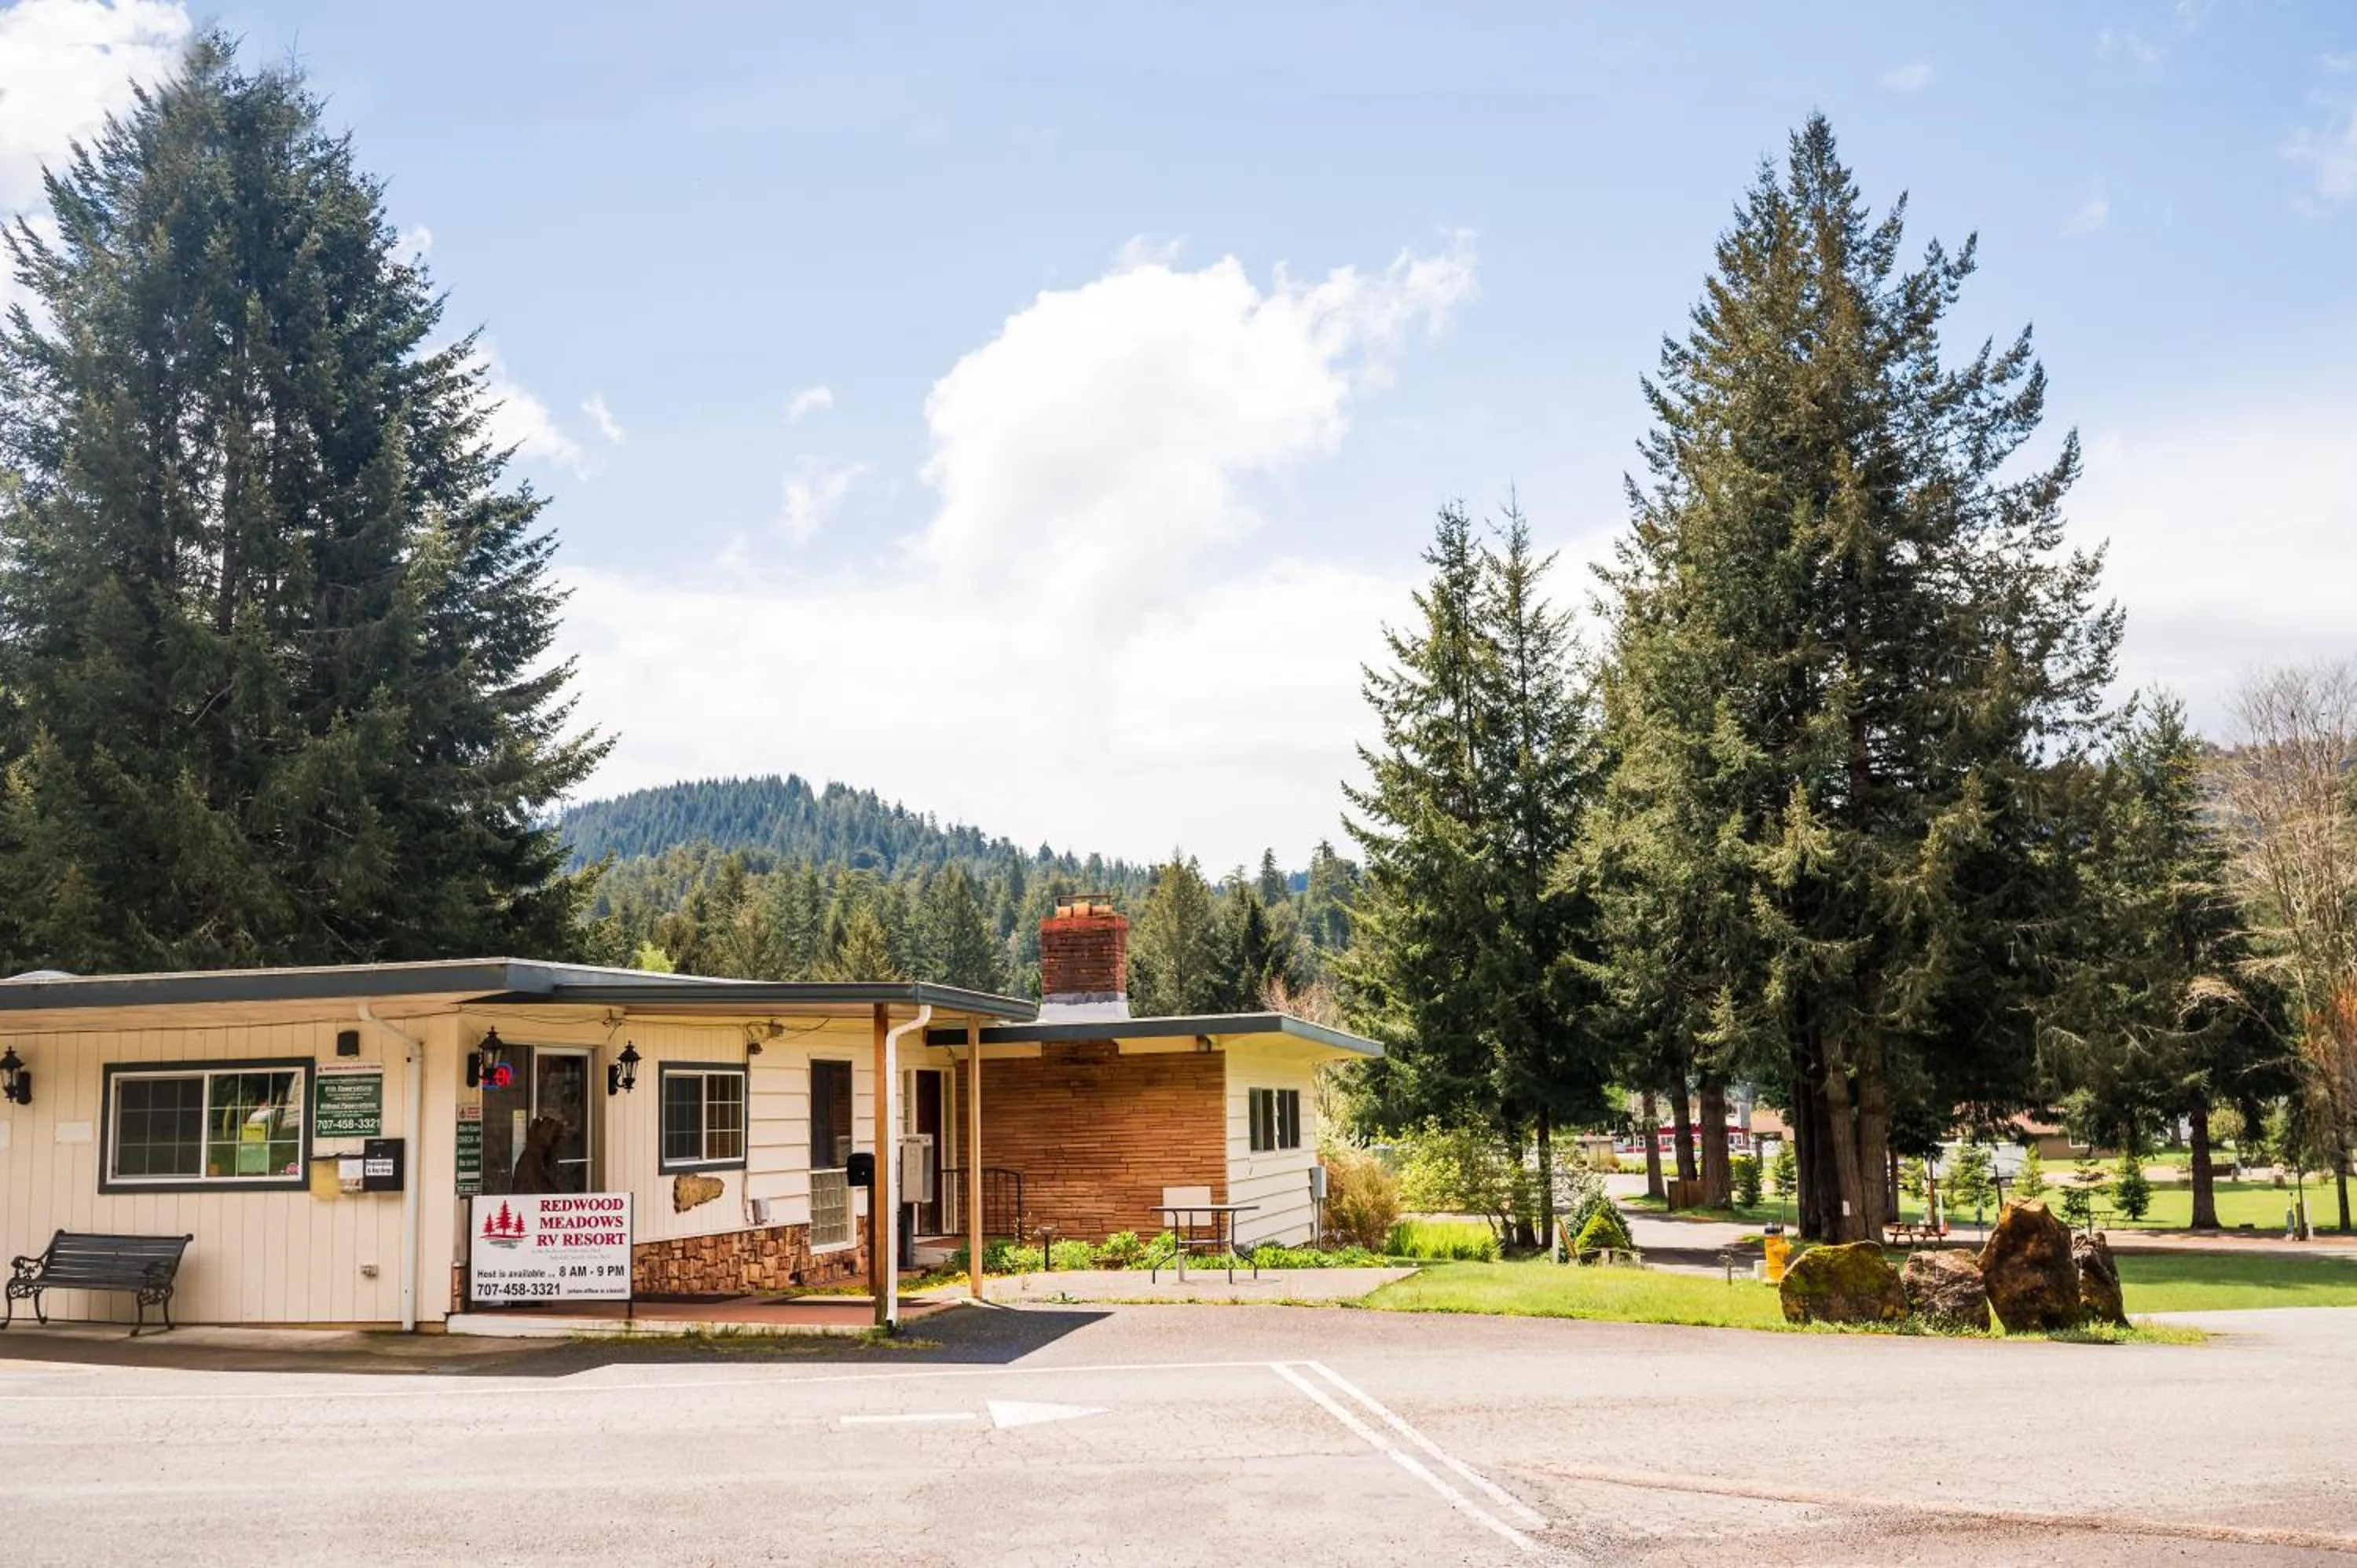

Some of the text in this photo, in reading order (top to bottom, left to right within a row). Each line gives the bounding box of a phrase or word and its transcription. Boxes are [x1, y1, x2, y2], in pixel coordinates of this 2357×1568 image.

[540, 1198, 624, 1211] REDWOOD
[540, 1216, 623, 1229] MEADOWS
[537, 1233, 626, 1246] RV RESORT
[477, 1269, 497, 1278] Host
[559, 1266, 566, 1277] 8
[570, 1266, 587, 1277] AM
[596, 1266, 604, 1277] 9
[607, 1265, 625, 1277] PM
[477, 1282, 560, 1295] 707-458-3321
